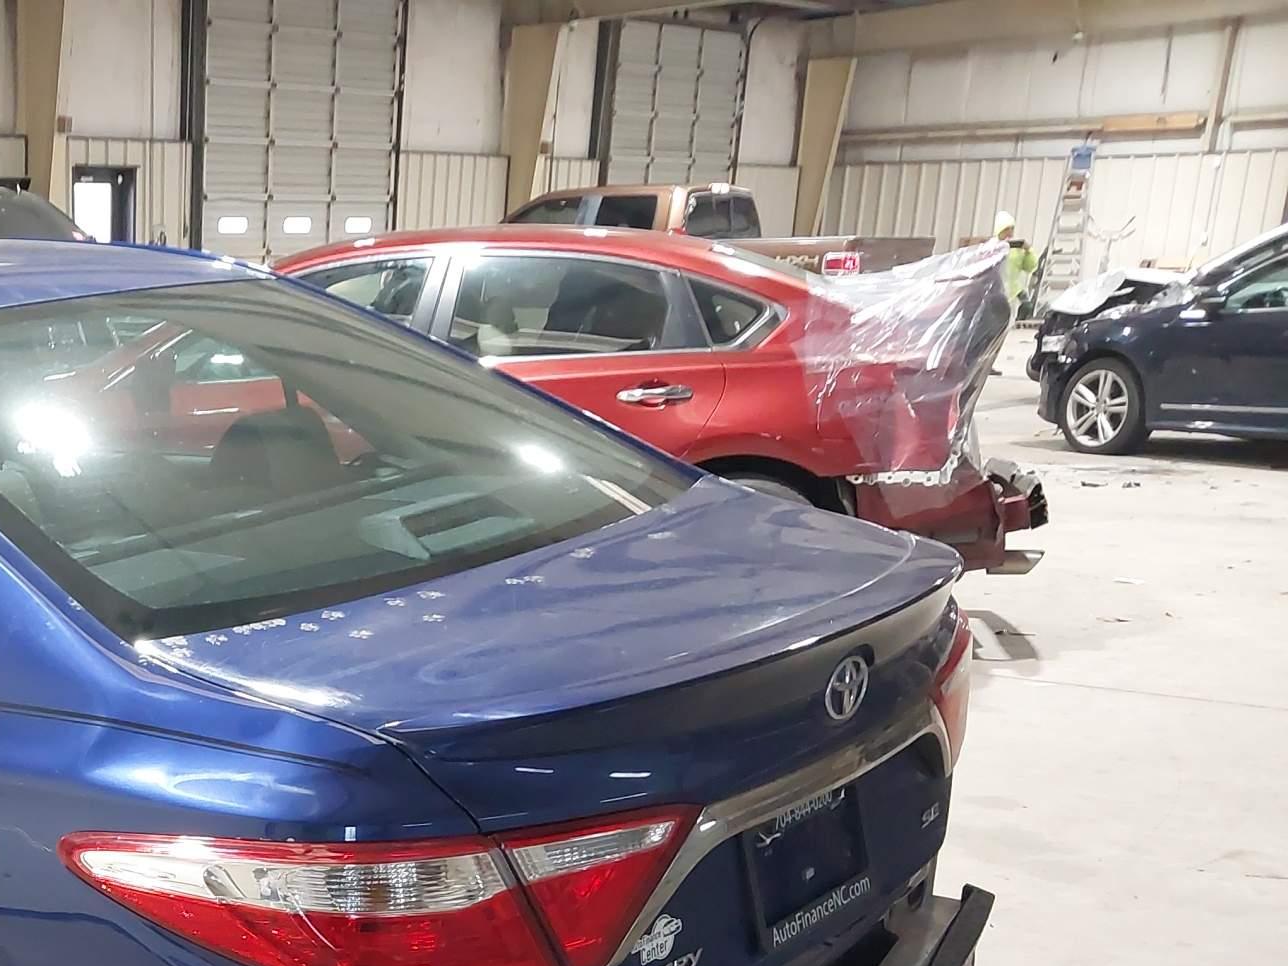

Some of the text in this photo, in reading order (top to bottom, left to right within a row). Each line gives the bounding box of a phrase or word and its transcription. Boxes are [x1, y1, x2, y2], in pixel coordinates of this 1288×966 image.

[921, 802, 940, 829] SE
[772, 876, 871, 948] AutoFinanceNC.com
[641, 940, 668, 964] Center
